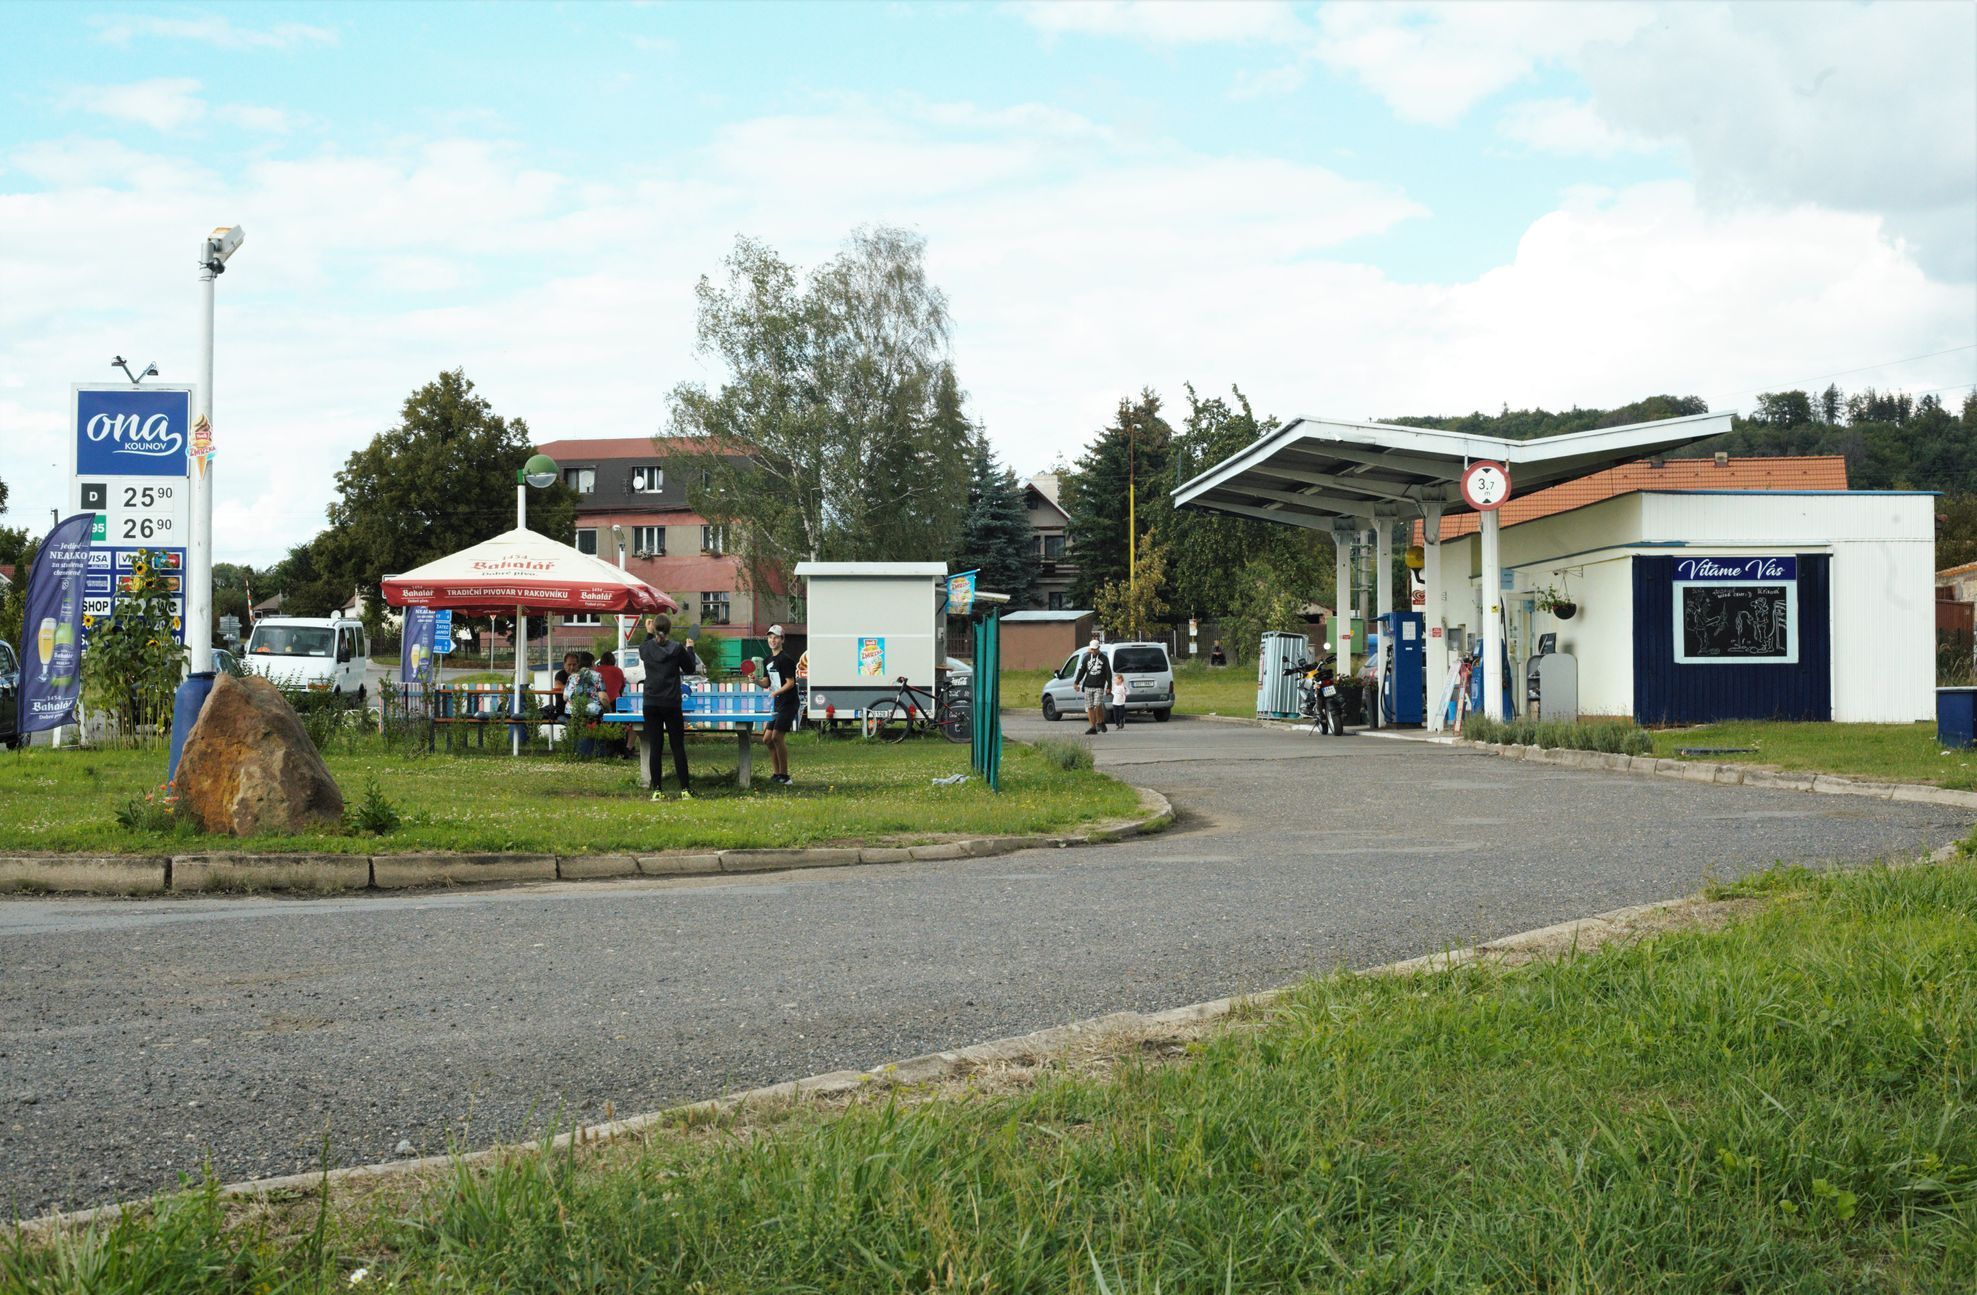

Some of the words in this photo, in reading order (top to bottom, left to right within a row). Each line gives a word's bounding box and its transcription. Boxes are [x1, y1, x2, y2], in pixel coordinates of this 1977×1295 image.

[87, 413, 182, 456] ona
[124, 442, 167, 451] KOUNOV
[89, 491, 99, 502] D
[123, 487, 155, 508] 25
[157, 487, 173, 498] 90
[122, 518, 154, 539] 26
[156, 519, 172, 530] 90
[49, 551, 88, 560] NEALKO
[472, 559, 555, 571] Bakalář
[1678, 559, 1742, 580] Vítáme
[1745, 558, 1786, 580] Vás
[402, 589, 434, 598] Bakalář
[447, 587, 482, 597] TRADIČNÍ
[484, 589, 517, 597] PIVOVAR
[524, 589, 569, 599] RAKOVNÍKU
[580, 591, 614, 601] Bakalář
[82, 601, 109, 613] SHOP
